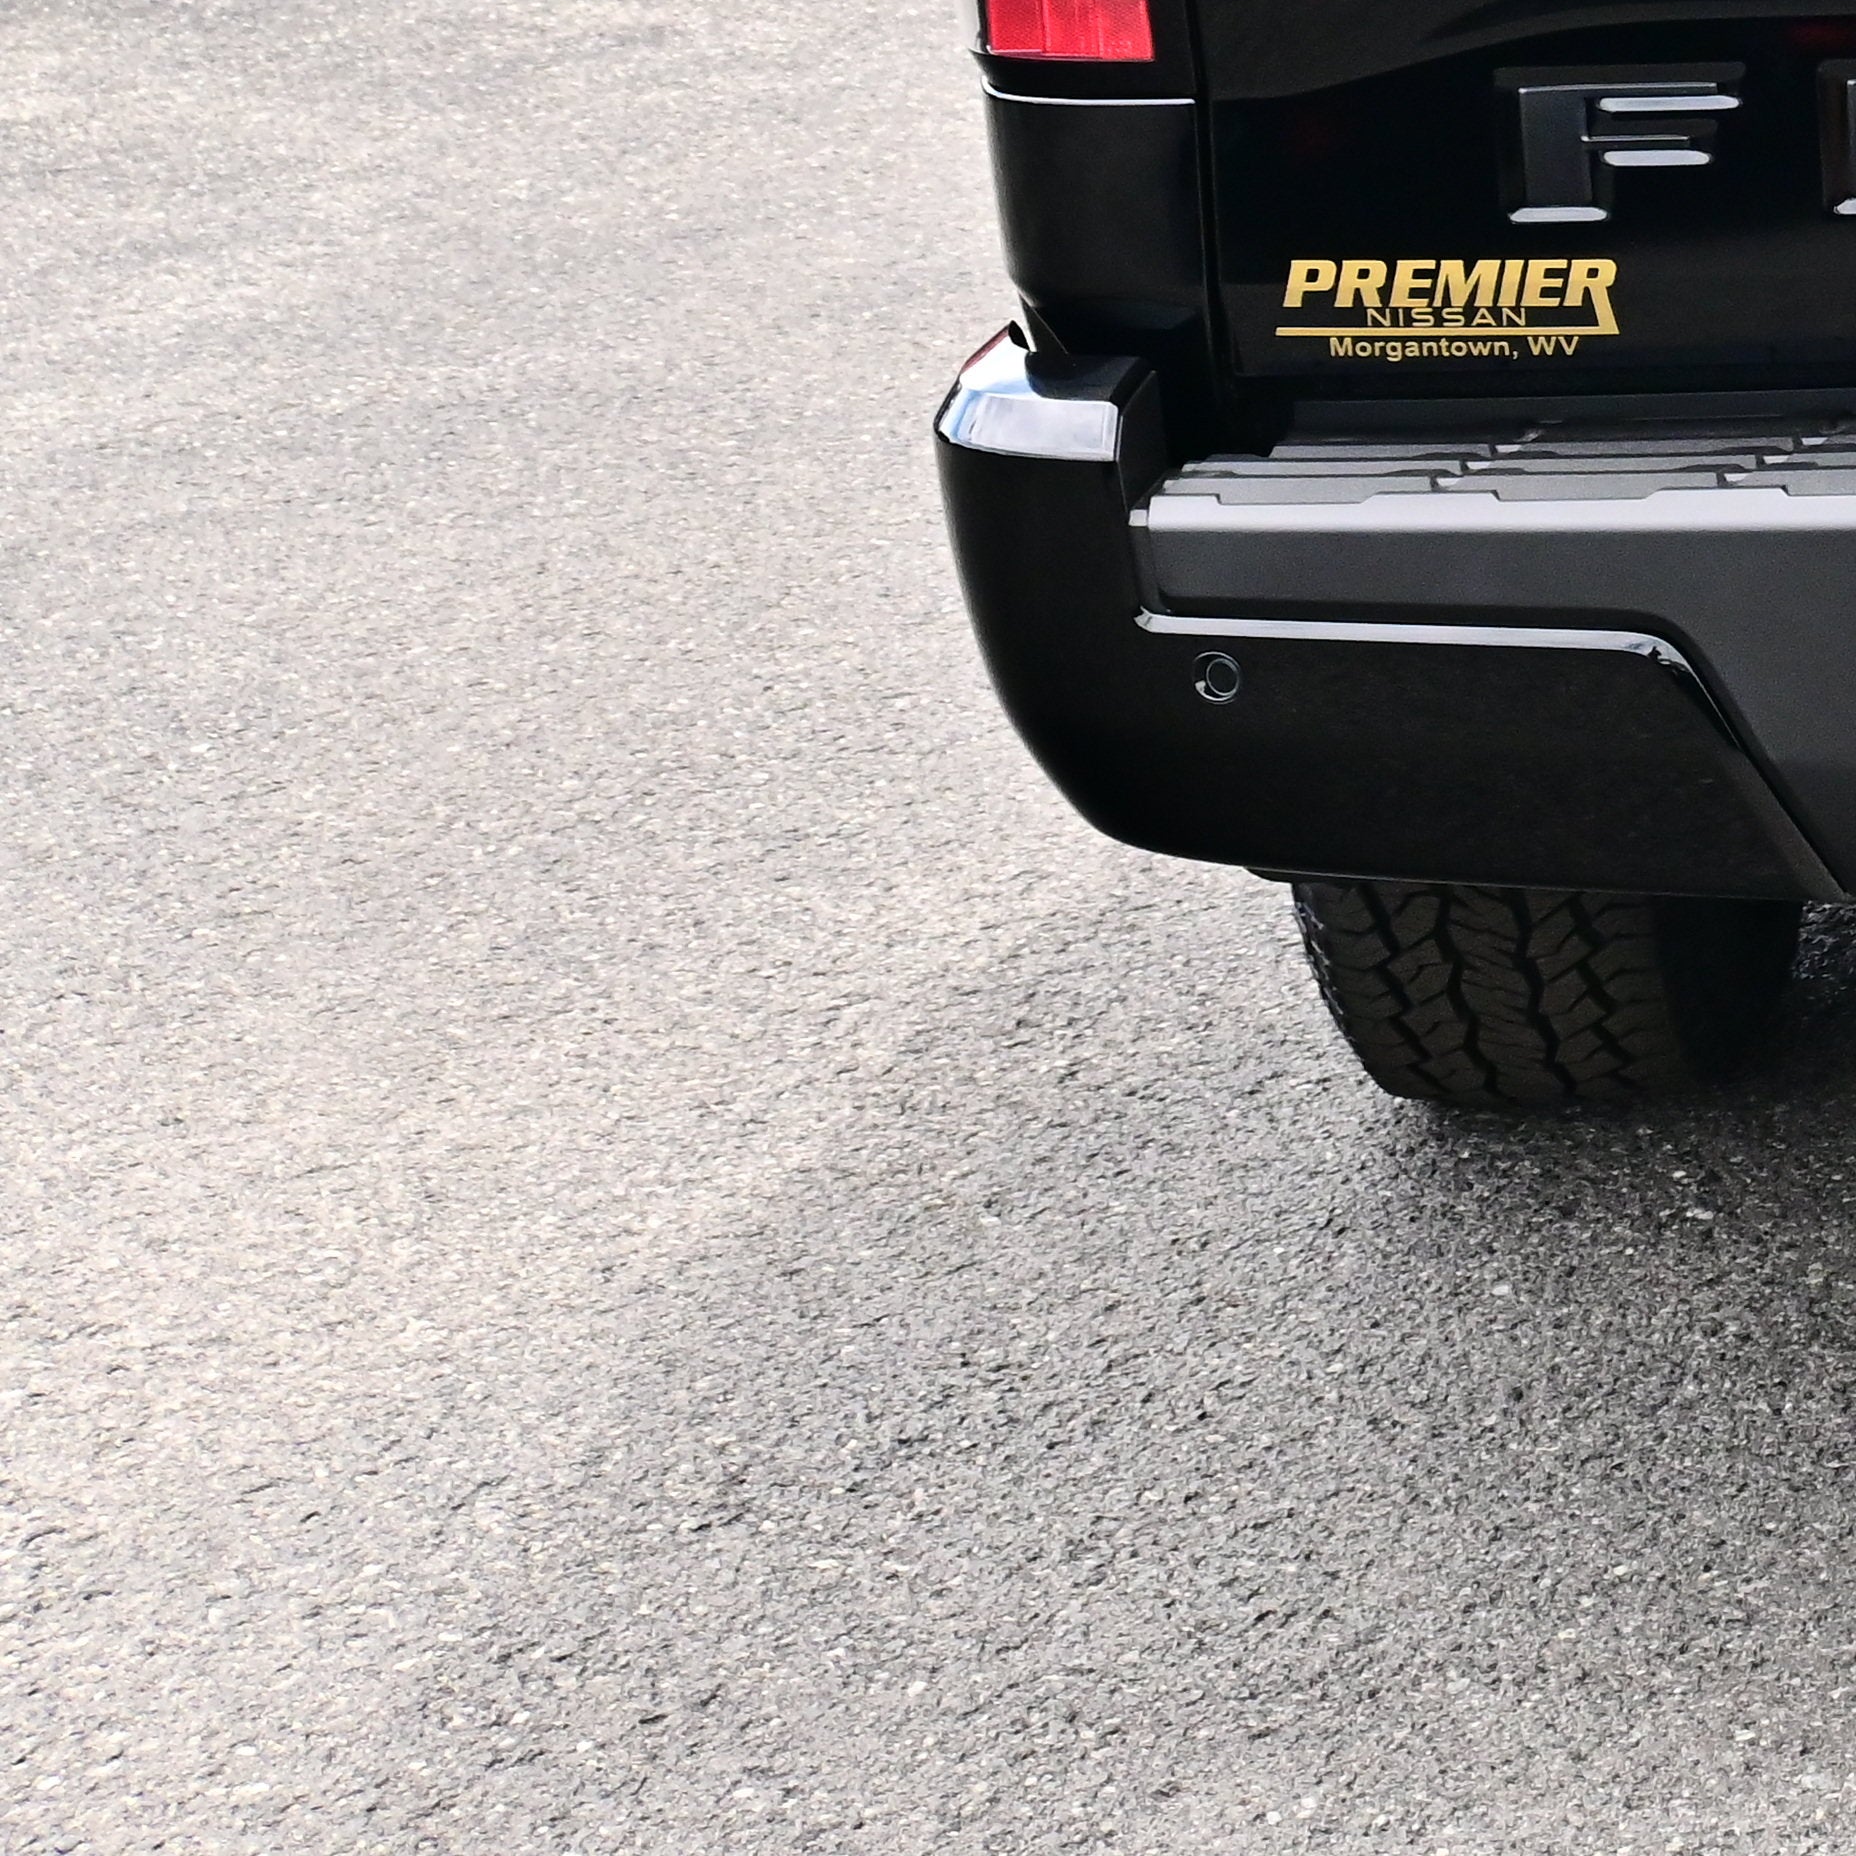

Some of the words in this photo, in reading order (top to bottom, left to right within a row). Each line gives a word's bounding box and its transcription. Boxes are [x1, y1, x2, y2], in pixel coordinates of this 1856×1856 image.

[1282, 258, 1620, 334] PREMIER
[1366, 307, 1526, 327] NISSAN
[1329, 337, 1519, 362] Morgantown,
[1527, 336, 1579, 356] WV
